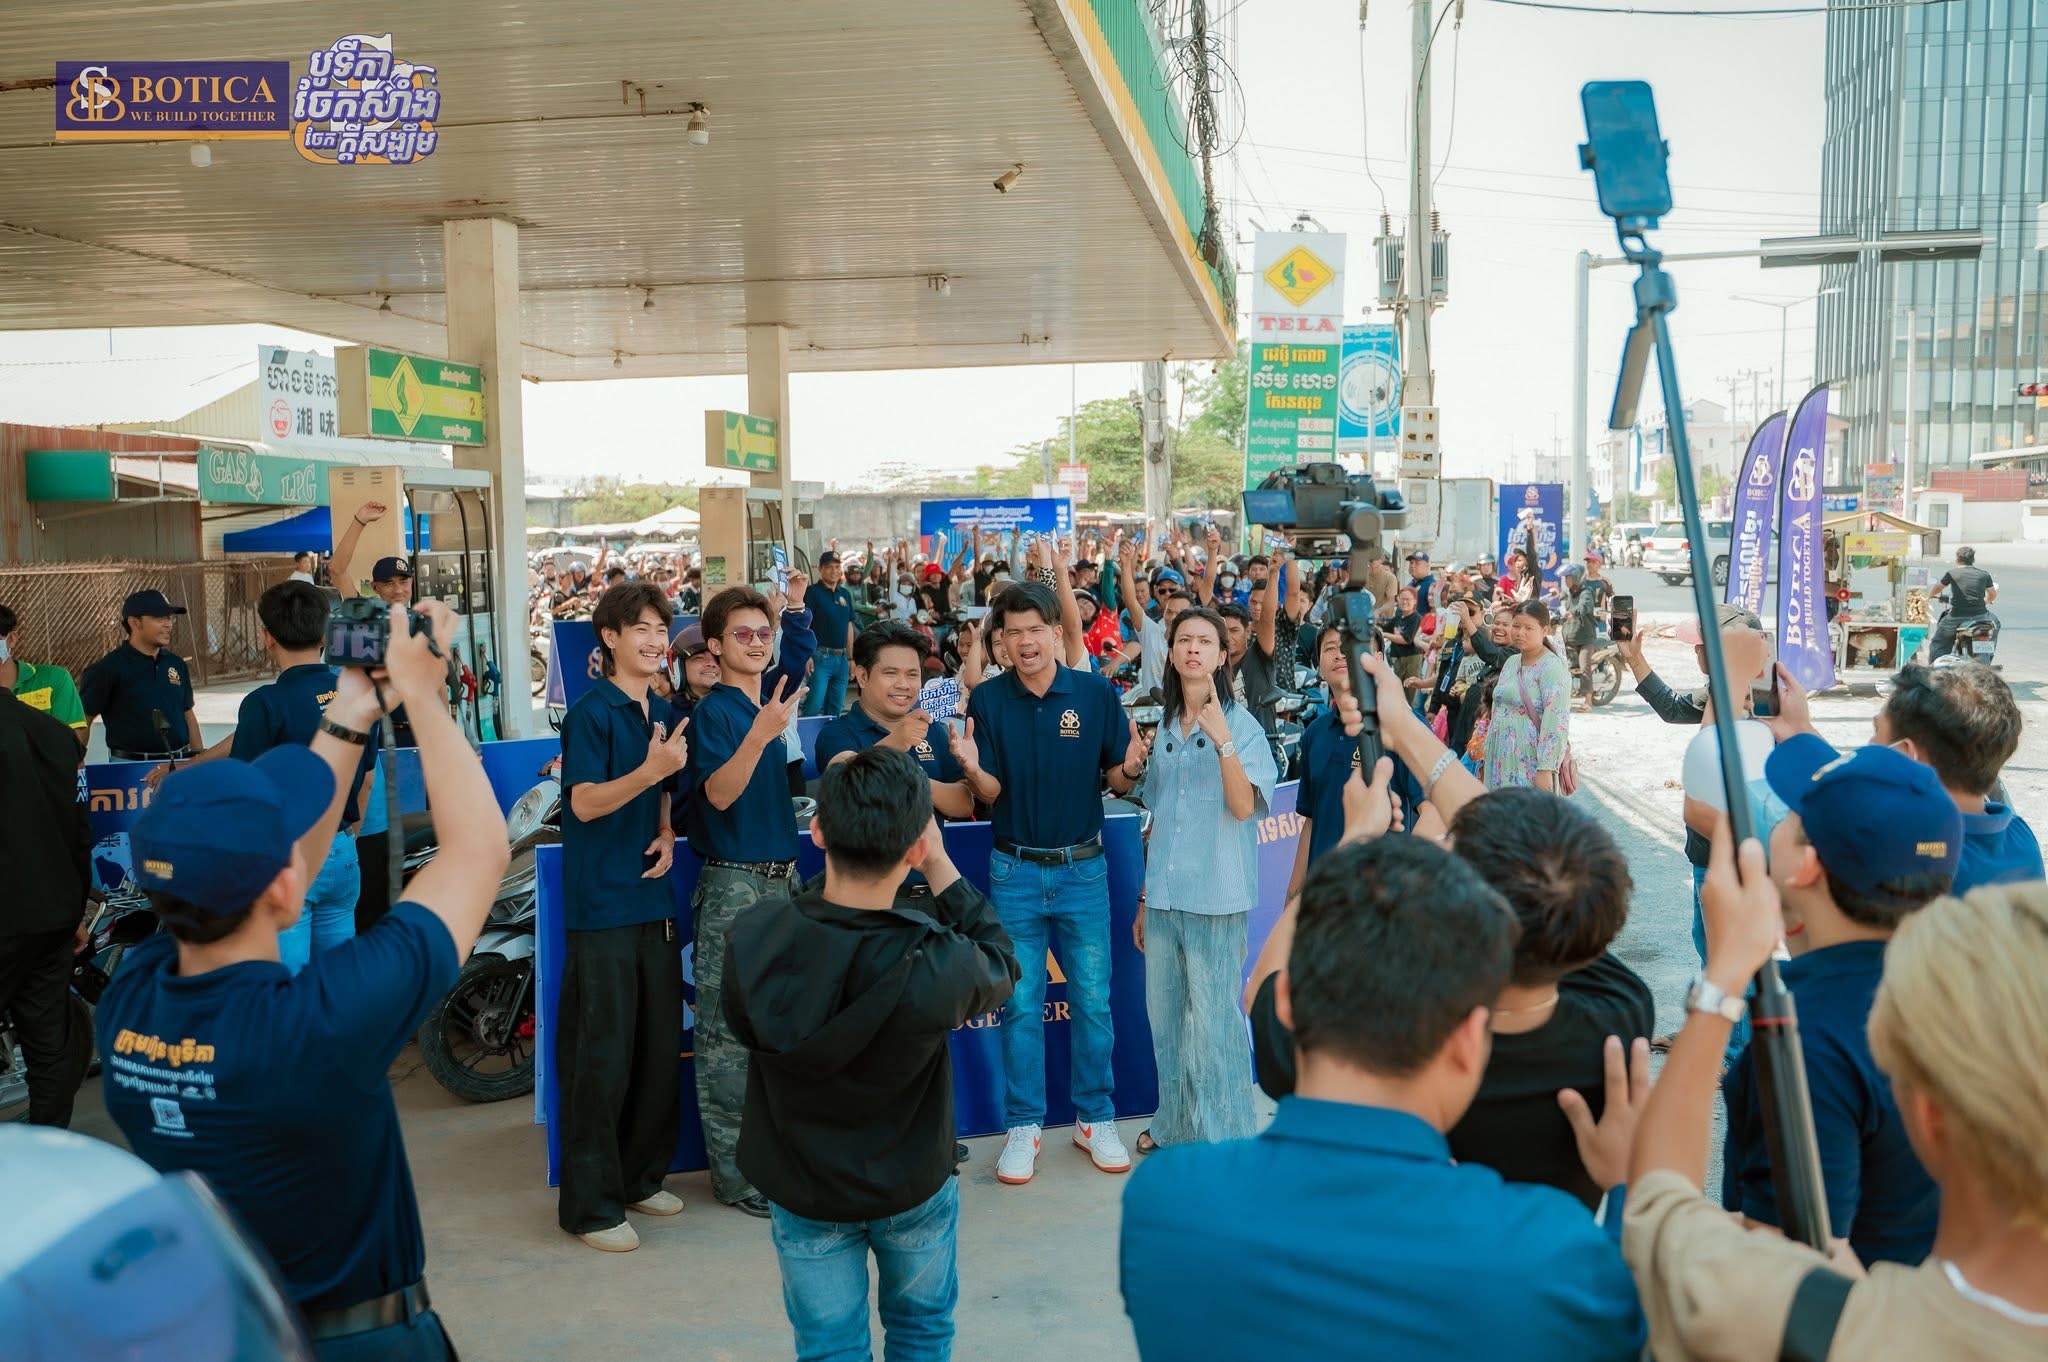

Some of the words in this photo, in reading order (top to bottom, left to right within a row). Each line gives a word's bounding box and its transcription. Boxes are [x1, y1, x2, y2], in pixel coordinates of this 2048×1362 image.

[1258, 317, 1336, 332] TELA
[208, 449, 248, 485] GAS
[281, 463, 317, 503] LPG
[1804, 586, 1813, 624] BUILD
